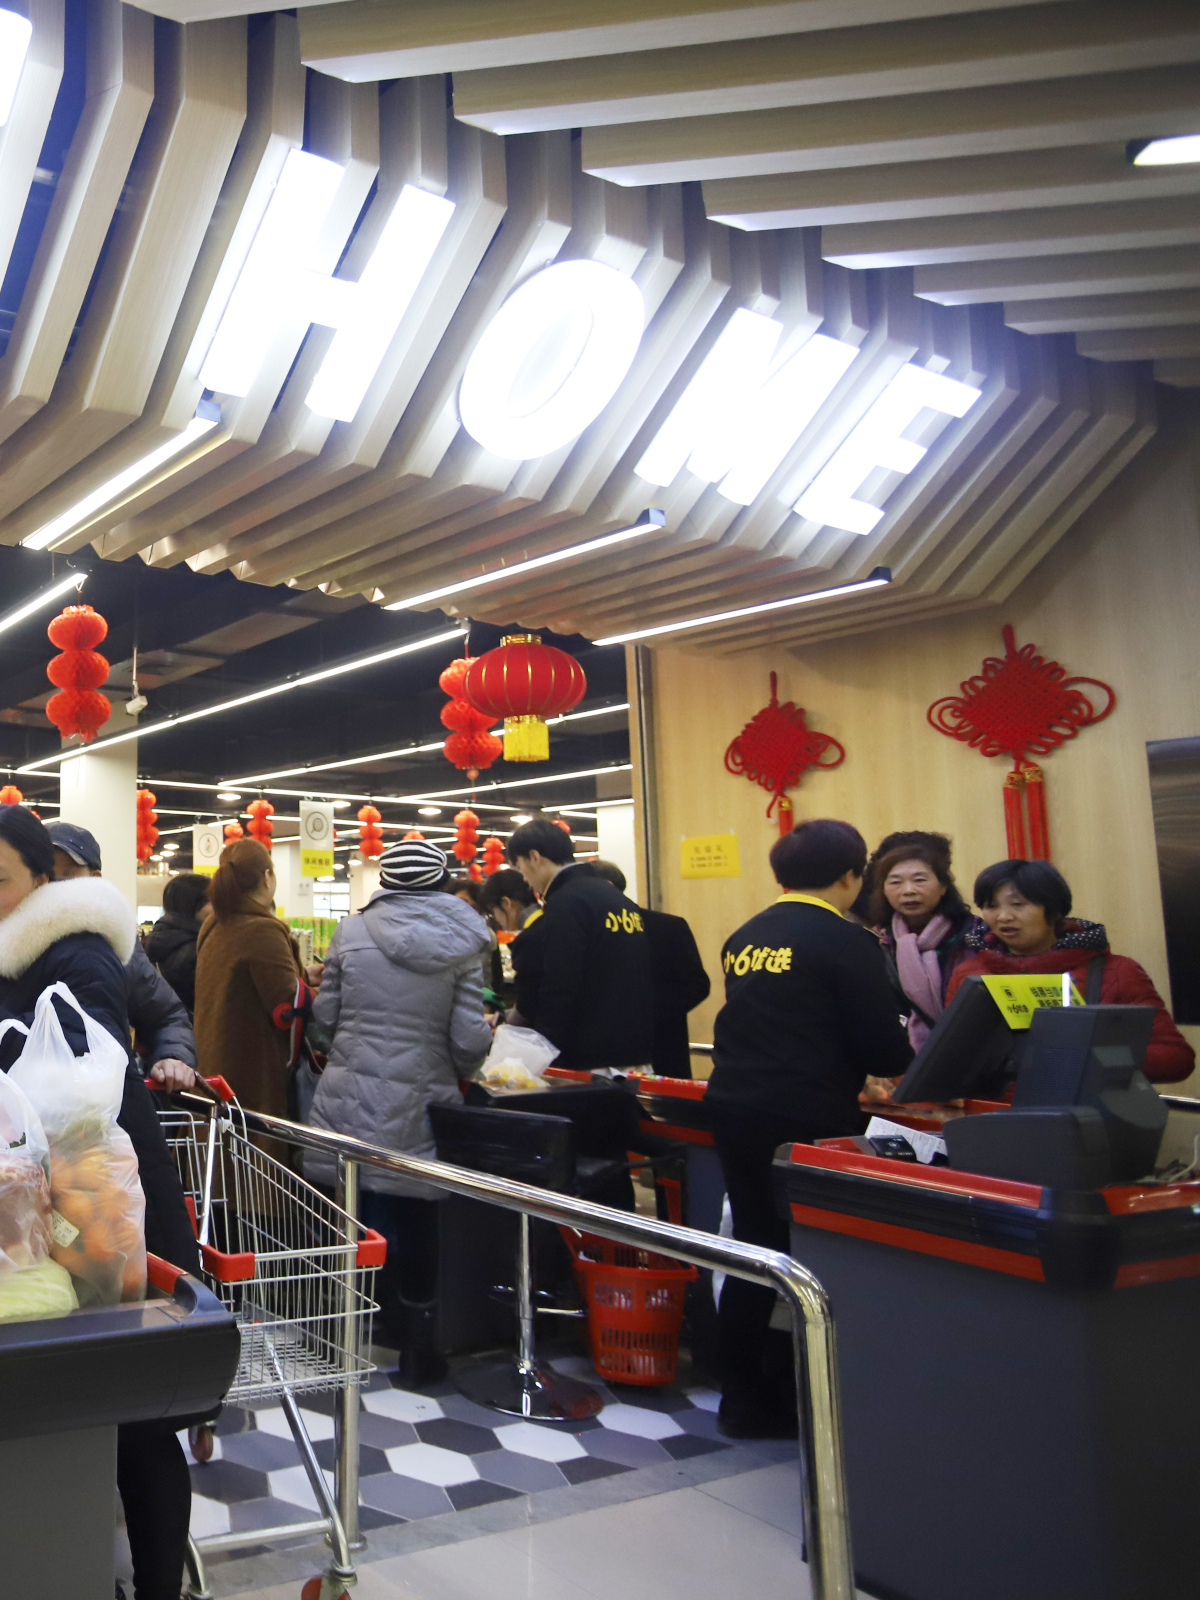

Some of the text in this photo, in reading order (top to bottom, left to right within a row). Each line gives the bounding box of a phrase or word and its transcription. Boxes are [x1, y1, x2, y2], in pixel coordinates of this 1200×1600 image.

[198, 147, 983, 536] HOME
[724, 944, 793, 976] 小6优选
